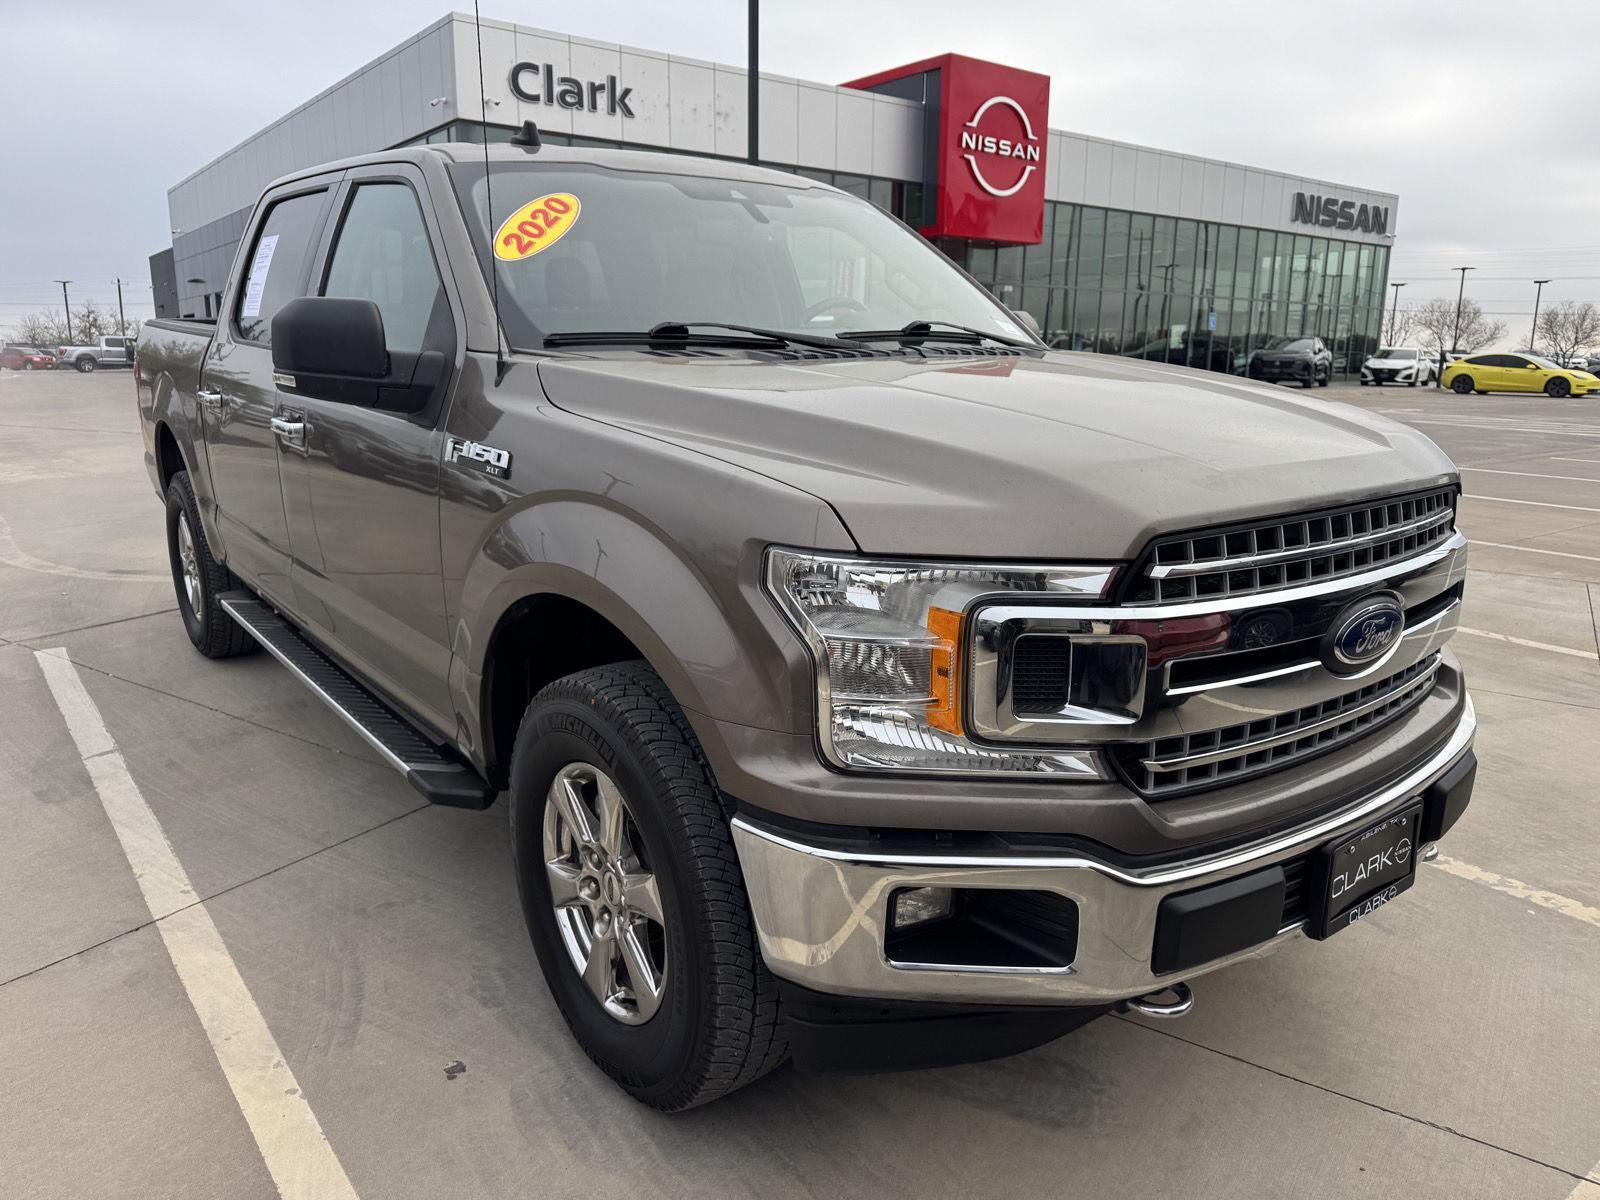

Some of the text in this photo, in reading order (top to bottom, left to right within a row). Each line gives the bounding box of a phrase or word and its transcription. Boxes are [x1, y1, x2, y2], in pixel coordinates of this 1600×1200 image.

[508, 62, 635, 118] Clark
[962, 131, 1039, 161] NISSAN
[503, 197, 570, 255] 2020
[1291, 192, 1389, 235] NISSAN
[485, 465, 500, 475] XLT
[1355, 616, 1395, 653] Ford
[1332, 846, 1393, 899] CLARK
[1349, 891, 1389, 924] CLARK
